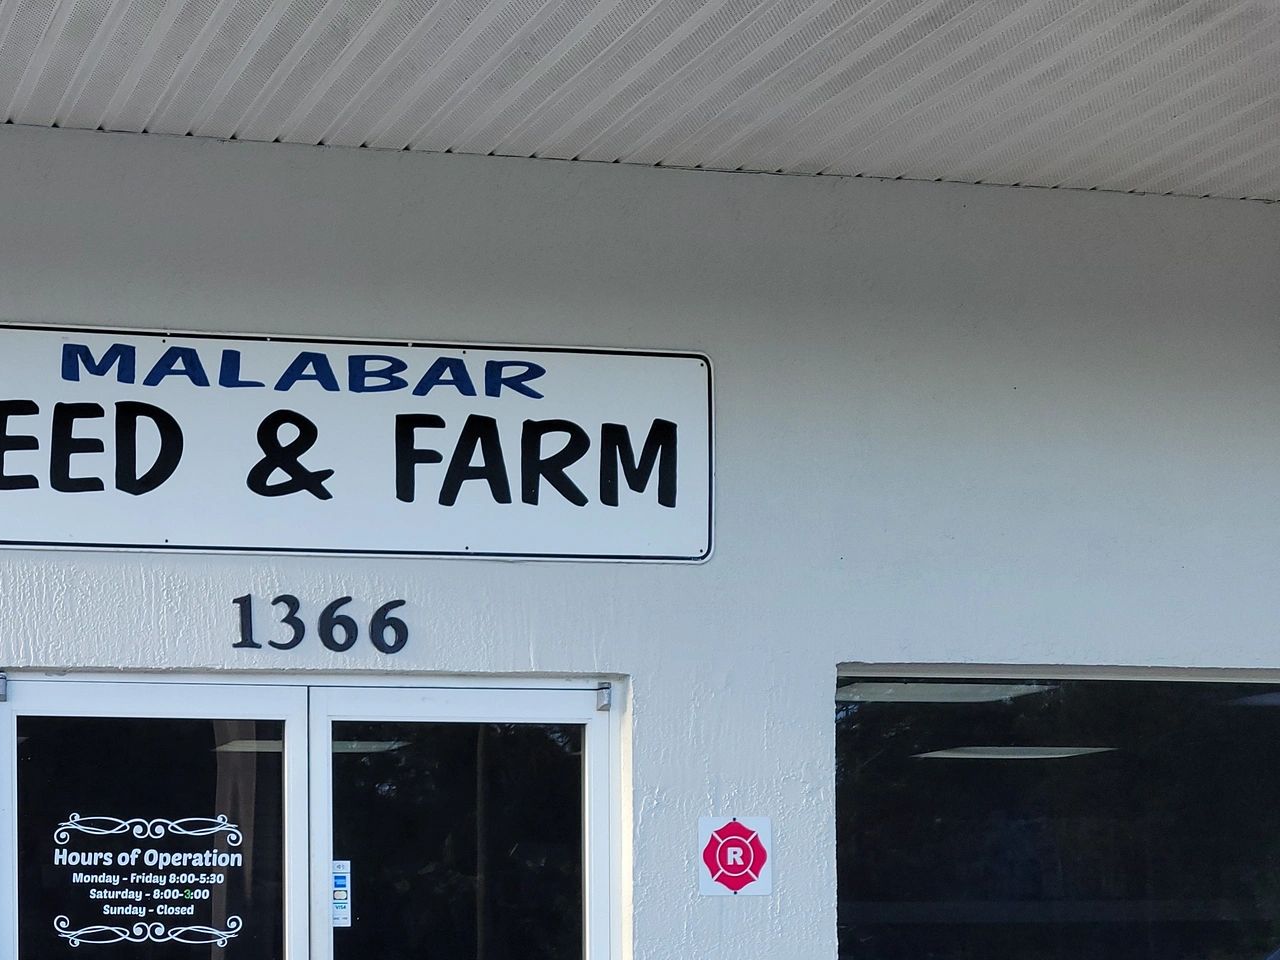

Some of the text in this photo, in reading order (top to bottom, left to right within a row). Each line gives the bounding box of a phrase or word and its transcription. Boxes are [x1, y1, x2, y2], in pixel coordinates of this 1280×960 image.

[60, 342, 547, 399] MALABAR
[246, 408, 336, 502] &
[394, 413, 679, 509] FARM
[231, 593, 411, 655] 1366
[54, 849, 243, 869] Hours of Operation
[727, 847, 745, 866] R
[72, 873, 120, 886] Monday
[130, 873, 167, 886] Friday
[169, 873, 224, 884] 8:00-5:30
[89, 889, 142, 901] Saturday
[153, 889, 210, 899] 8:00-3:00
[103, 905, 146, 917] Sunday
[157, 905, 194, 915] Closed
